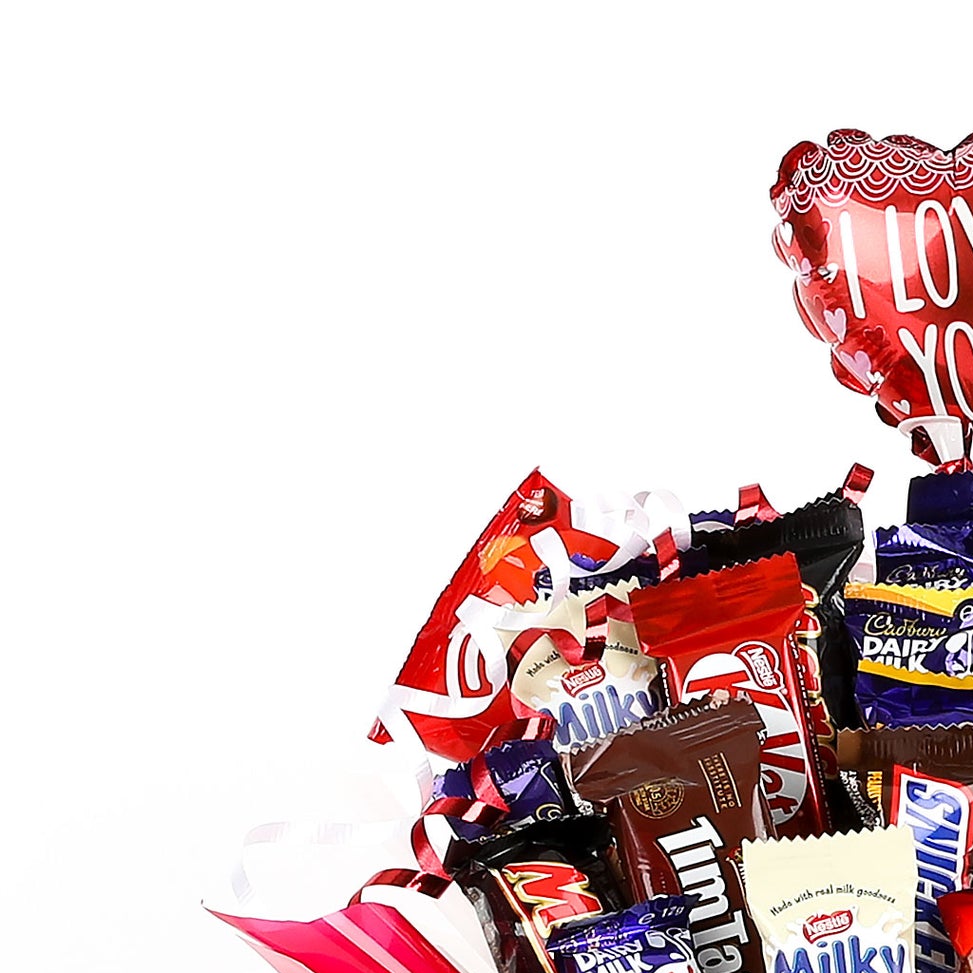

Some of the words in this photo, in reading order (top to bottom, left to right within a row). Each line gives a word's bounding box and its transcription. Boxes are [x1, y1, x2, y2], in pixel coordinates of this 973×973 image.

[839, 210, 866, 320] I
[864, 613, 948, 637] Cadbury
[862, 635, 950, 658] DAIRY
[769, 898, 793, 917] Made
[793, 888, 814, 905] with
[815, 883, 834, 898] real
[836, 883, 855, 894] milk
[856, 888, 896, 905] goodness
[572, 939, 644, 972] DAIRY
